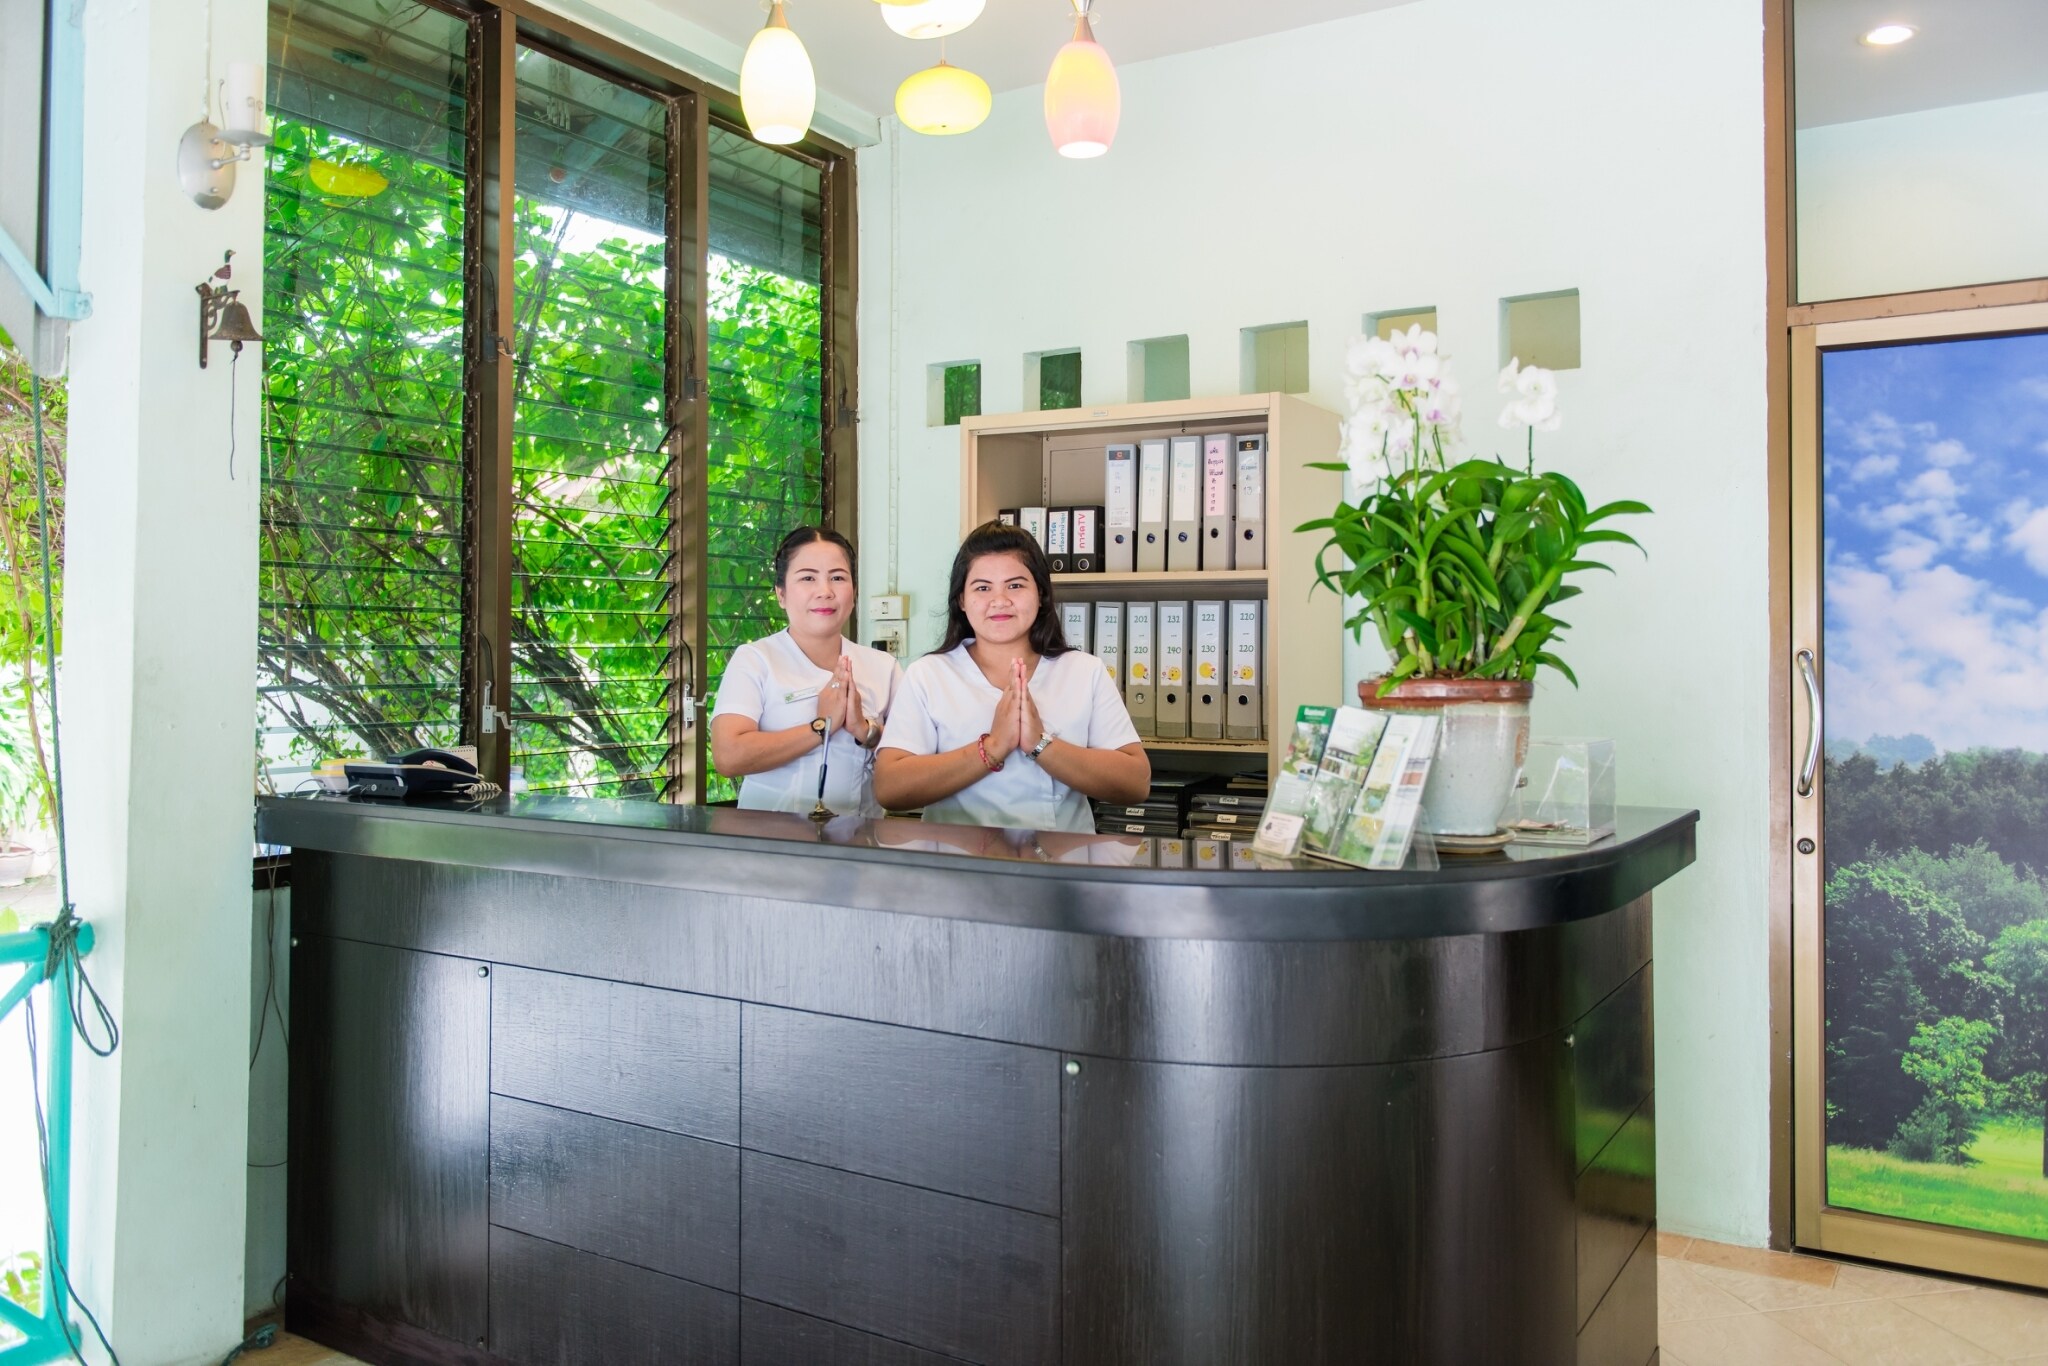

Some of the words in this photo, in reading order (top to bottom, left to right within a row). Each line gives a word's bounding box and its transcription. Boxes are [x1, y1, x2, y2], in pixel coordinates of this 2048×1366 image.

[1103, 645, 1118, 654] 220
[1167, 646, 1182, 654] 140
[1201, 645, 1216, 653] 130
[1239, 644, 1254, 653] 120
